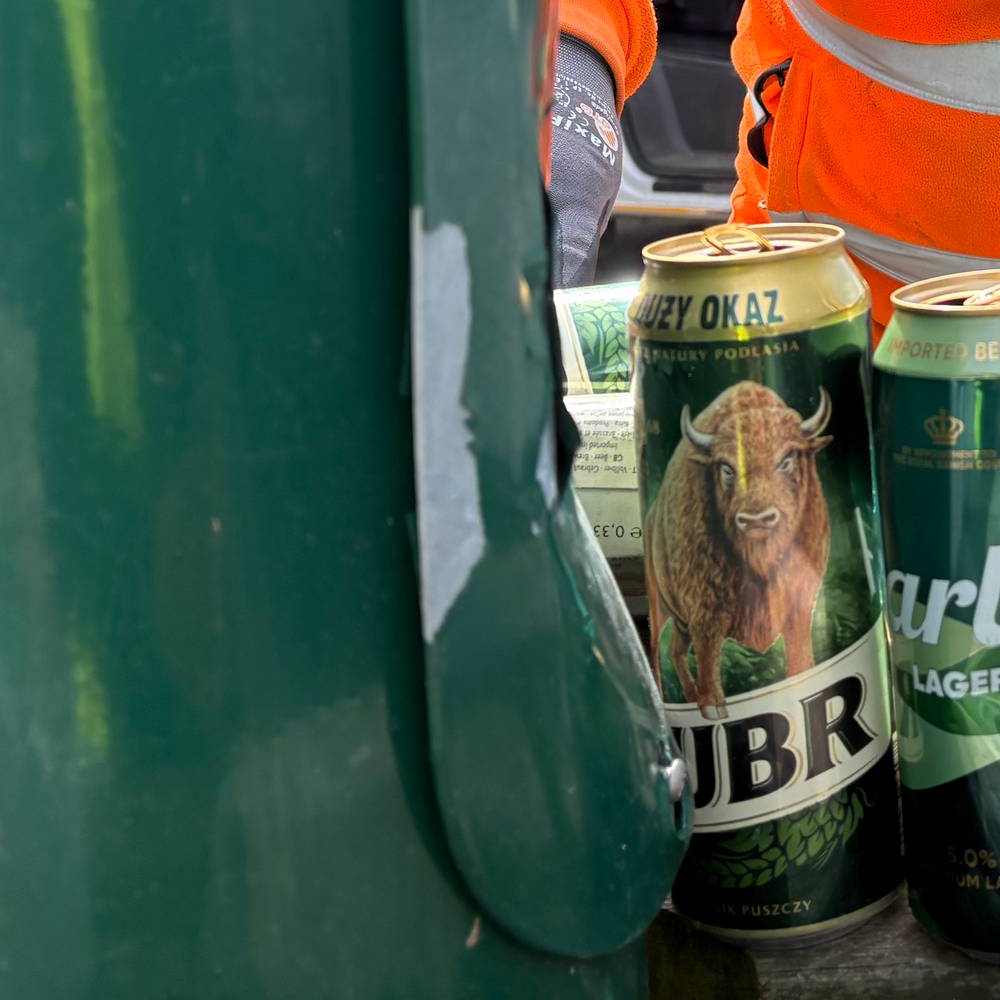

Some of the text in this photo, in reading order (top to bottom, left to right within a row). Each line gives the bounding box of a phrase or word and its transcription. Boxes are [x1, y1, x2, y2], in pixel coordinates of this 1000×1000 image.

[700, 288, 784, 330] OKAZ
[714, 340, 801, 361] PODLASIA
[945, 845, 998, 869] 5.0%
[741, 900, 812, 917] PUSZCZY
